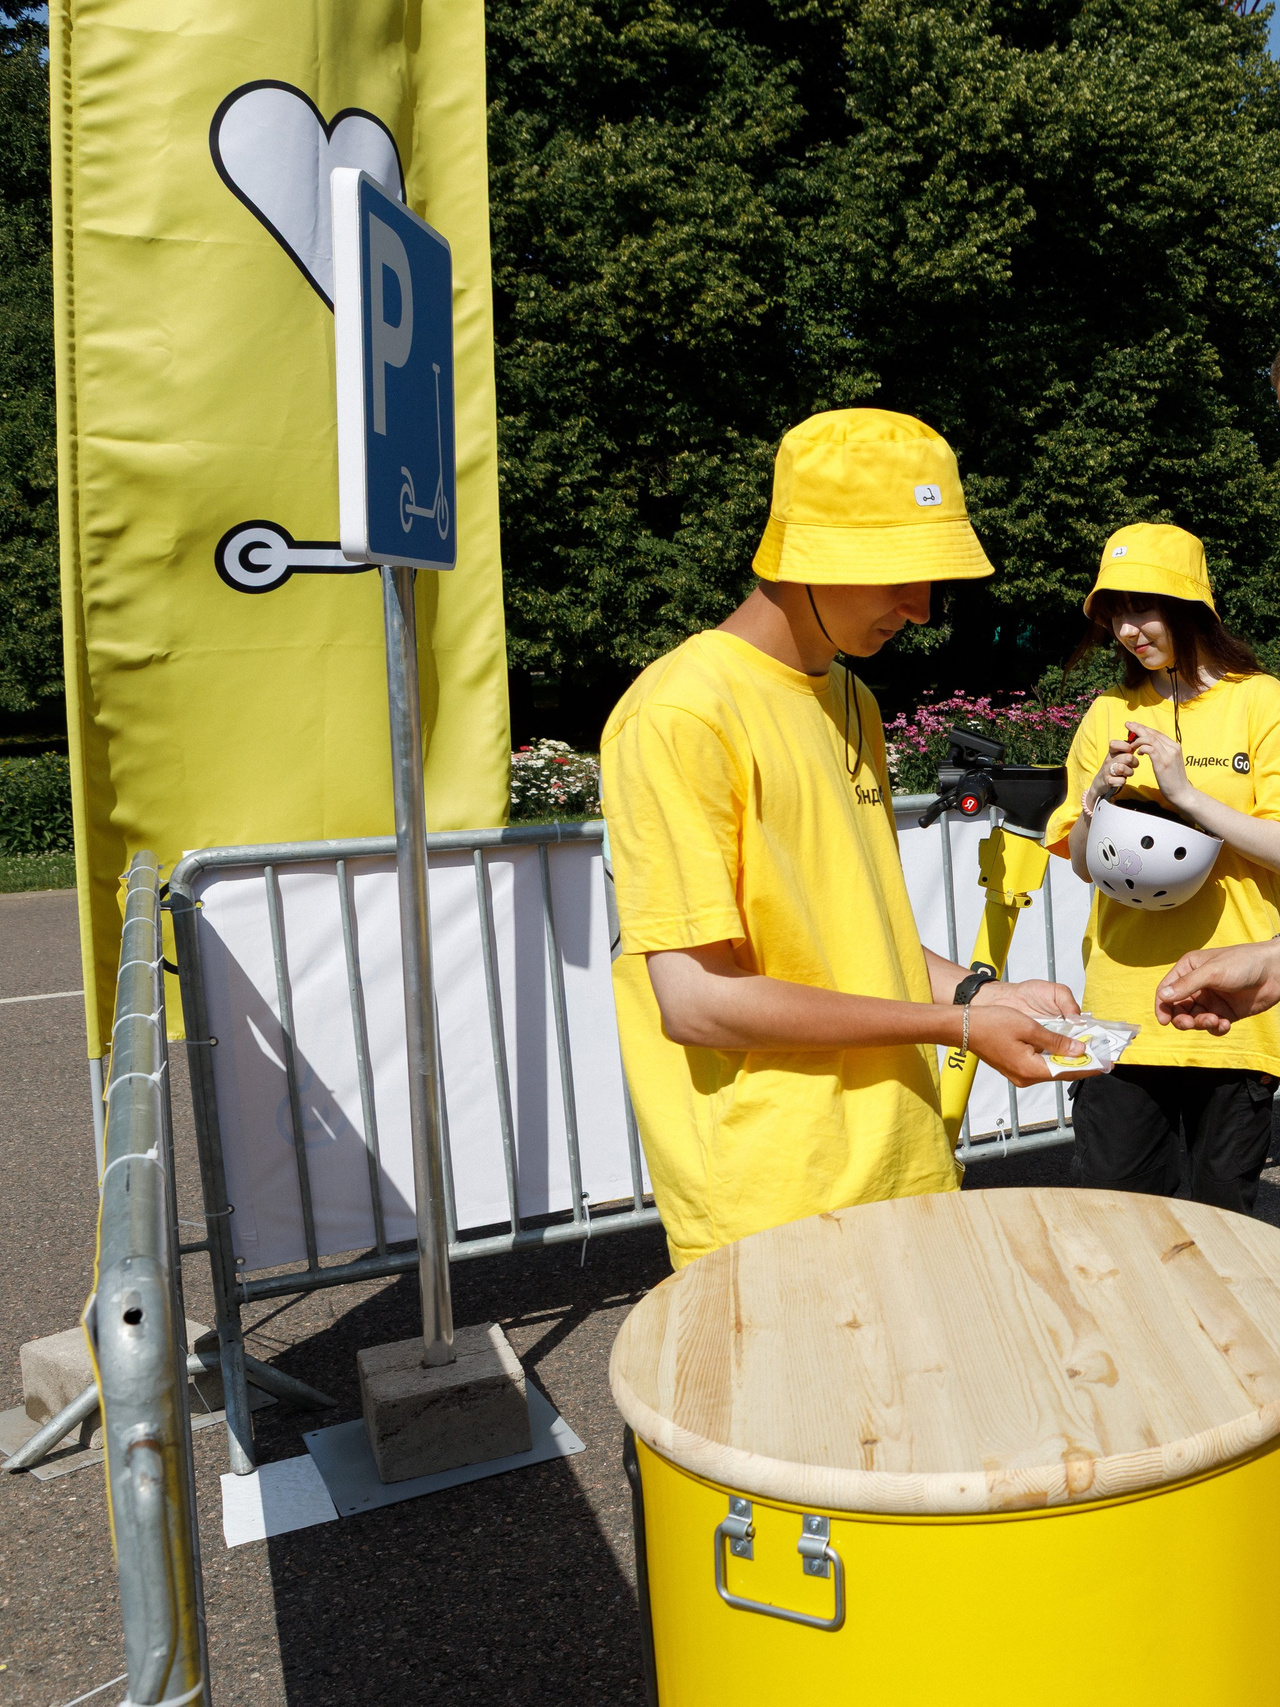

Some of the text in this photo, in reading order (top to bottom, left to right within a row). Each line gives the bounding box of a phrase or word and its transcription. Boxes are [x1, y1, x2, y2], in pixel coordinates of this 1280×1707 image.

[369, 211, 413, 436] P
[1185, 755, 1250, 771] Яндекс Go
[855, 784, 883, 806] Янд
[964, 799, 975, 809] Я
